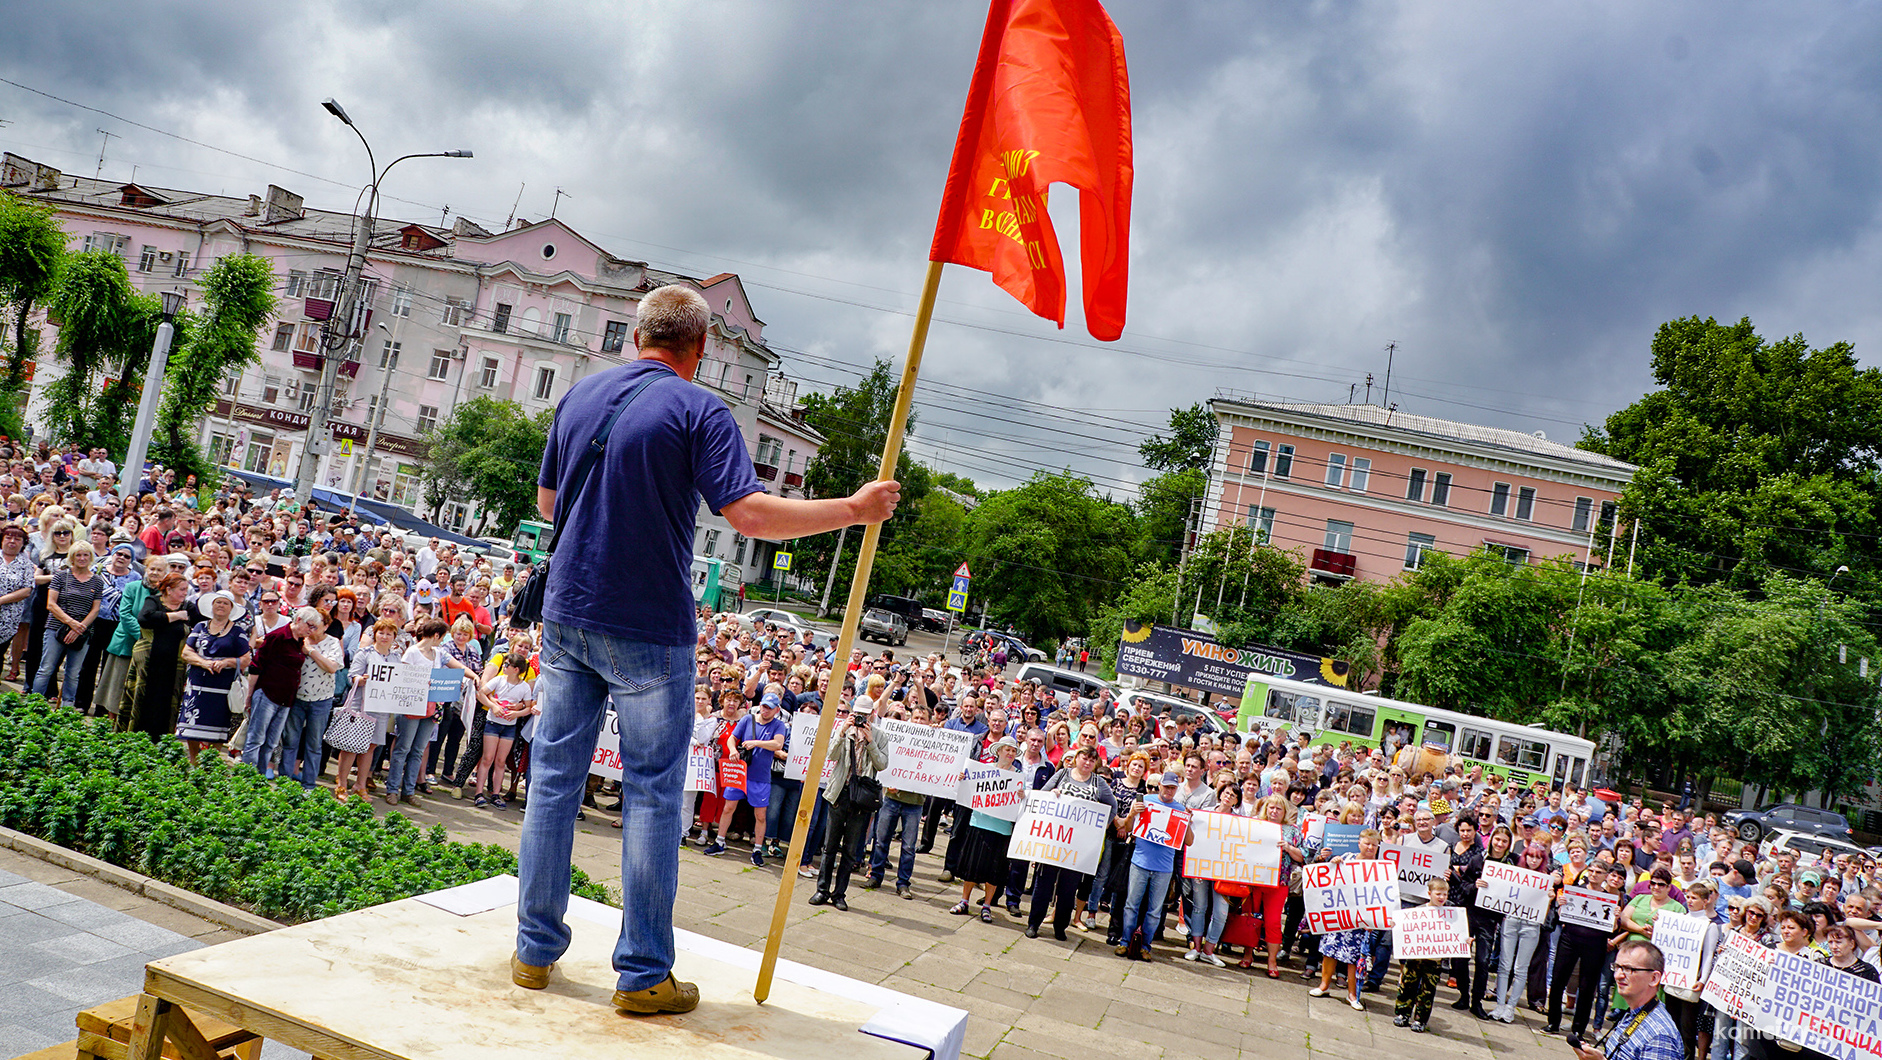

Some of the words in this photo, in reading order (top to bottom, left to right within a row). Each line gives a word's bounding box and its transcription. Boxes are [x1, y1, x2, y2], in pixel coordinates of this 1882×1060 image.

[1123, 646, 1155, 658] ПРИЕМ
[1181, 637, 1296, 677] УМНОЖИТЬ
[1122, 653, 1181, 672] СБЕРЕЖЕНИЙ
[1129, 664, 1168, 678] 330-777
[1209, 665, 1225, 675] ЛЕТ
[1193, 677, 1213, 687] ГОСТИ
[1218, 683, 1232, 691] НАМ
[1194, 671, 1231, 683] ПРИХОДИТЕ
[885, 721, 936, 738] ПЕНСИОННАЯ
[693, 745, 712, 758] КТО
[895, 745, 955, 765] ПРАВИТЕЛЬСТВО
[697, 768, 710, 780] НЕ
[916, 761, 923, 770] В
[976, 778, 1012, 793] НАЛОГ
[971, 795, 983, 808] НА
[1029, 819, 1074, 845] НАМ
[1207, 813, 1262, 845] НДС
[1015, 840, 1078, 866] ЛАПШУ!
[1220, 842, 1247, 862] НЕ
[1383, 849, 1401, 873] Я
[1411, 852, 1433, 868] НЕ
[1185, 857, 1280, 885] ПРОЙДЁТ
[1305, 861, 1393, 889] ХВАТИТ
[1398, 868, 1434, 886] ДОХН
[1486, 865, 1550, 892] ЗАПЛАТИ
[1322, 888, 1347, 909] ЗА
[1354, 885, 1395, 906] НАС
[1508, 885, 1519, 900] И
[1403, 908, 1454, 921] ХВАТИТ
[1481, 895, 1540, 922] СДОХНИ
[1308, 906, 1393, 933] РЕШАТЬ
[1402, 920, 1451, 933] ШАРИТЬ
[1661, 916, 1702, 935] НАШИ
[1403, 934, 1411, 944] В
[1416, 933, 1460, 943] НАШИХ
[1654, 932, 1700, 953] НАЛОГИ
[1730, 934, 1772, 962] ДЕПУТА
[1661, 971, 1687, 988] ХТА
[1728, 983, 1762, 1006] ВОЗРАС
[1760, 998, 1794, 1022] ЭТО
[1774, 985, 1878, 1036] ВОЗРАСТА
